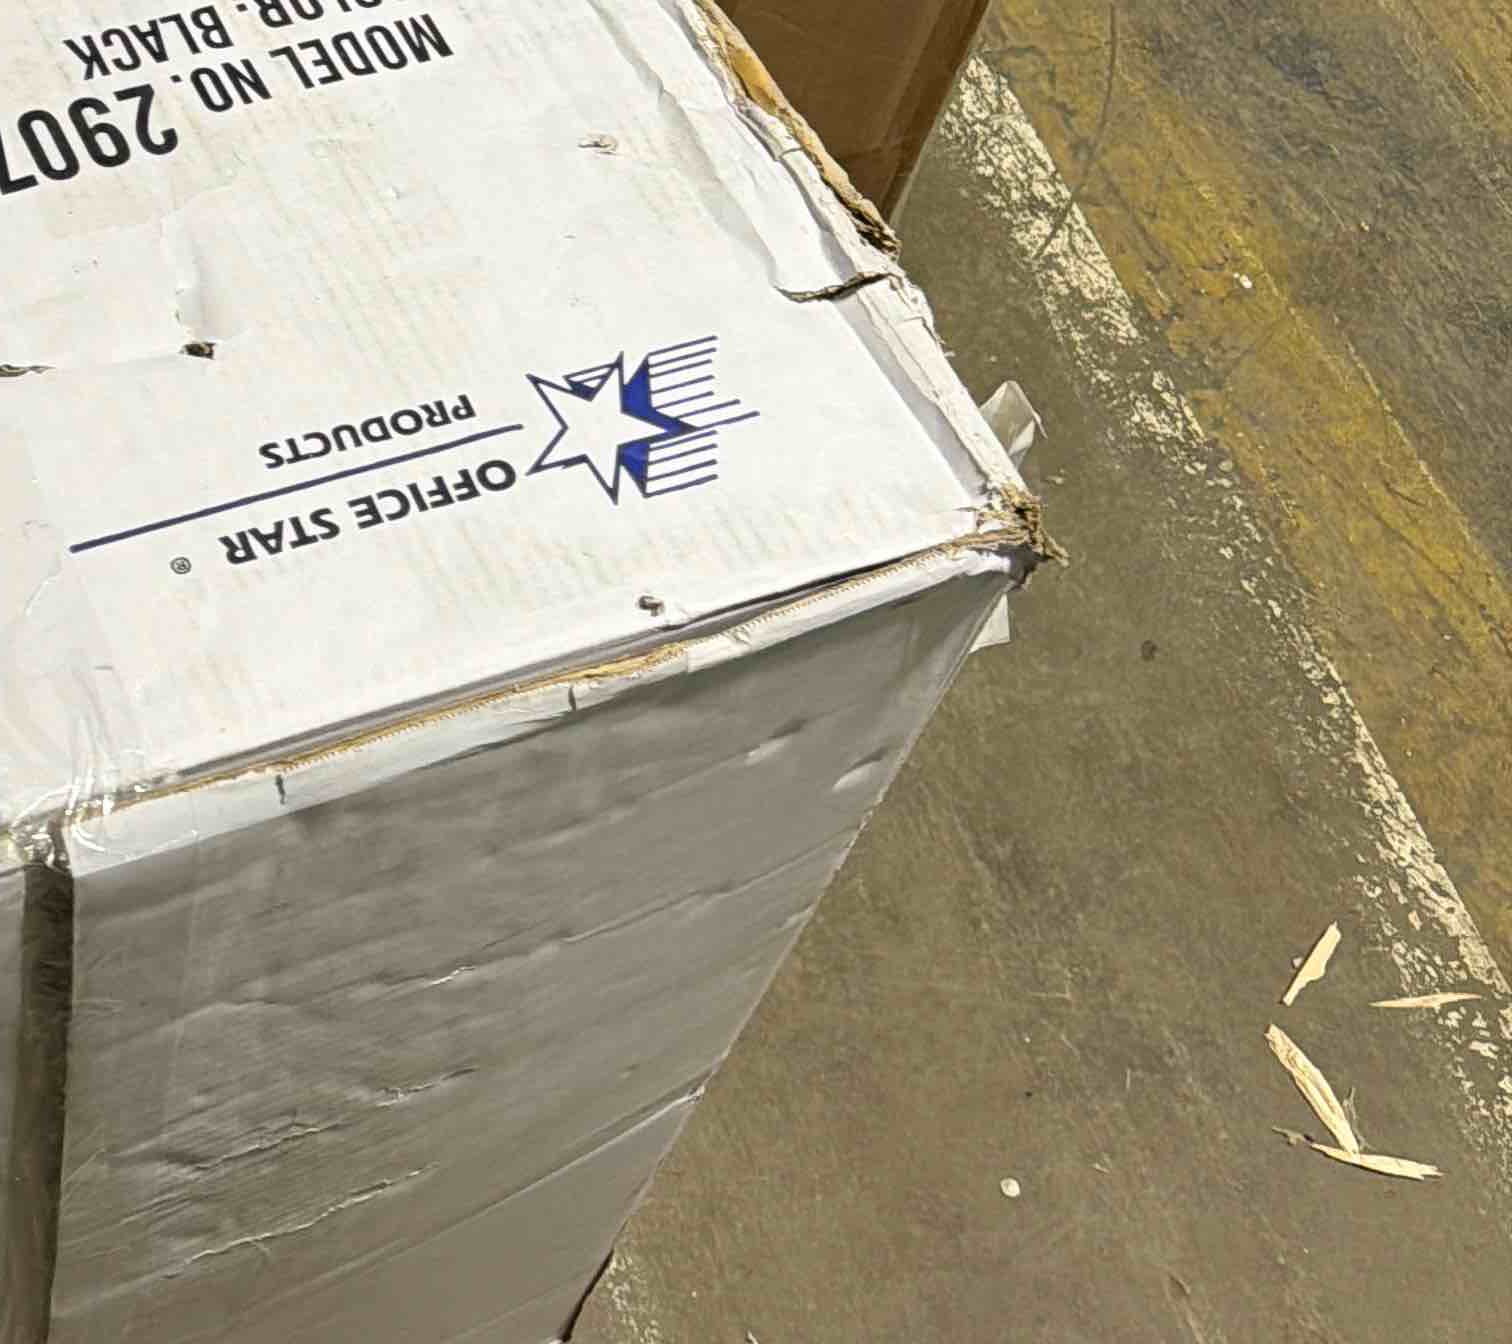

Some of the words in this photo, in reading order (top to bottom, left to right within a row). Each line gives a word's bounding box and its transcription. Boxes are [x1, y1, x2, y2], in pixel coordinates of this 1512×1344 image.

[63, 6, 235, 80] BLACK
[269, 13, 454, 89] MODEL
[170, 58, 272, 112] NO.
[258, 394, 476, 469] PRODUCTS
[356, 460, 517, 530] OFFICE
[219, 507, 340, 565] STAR
